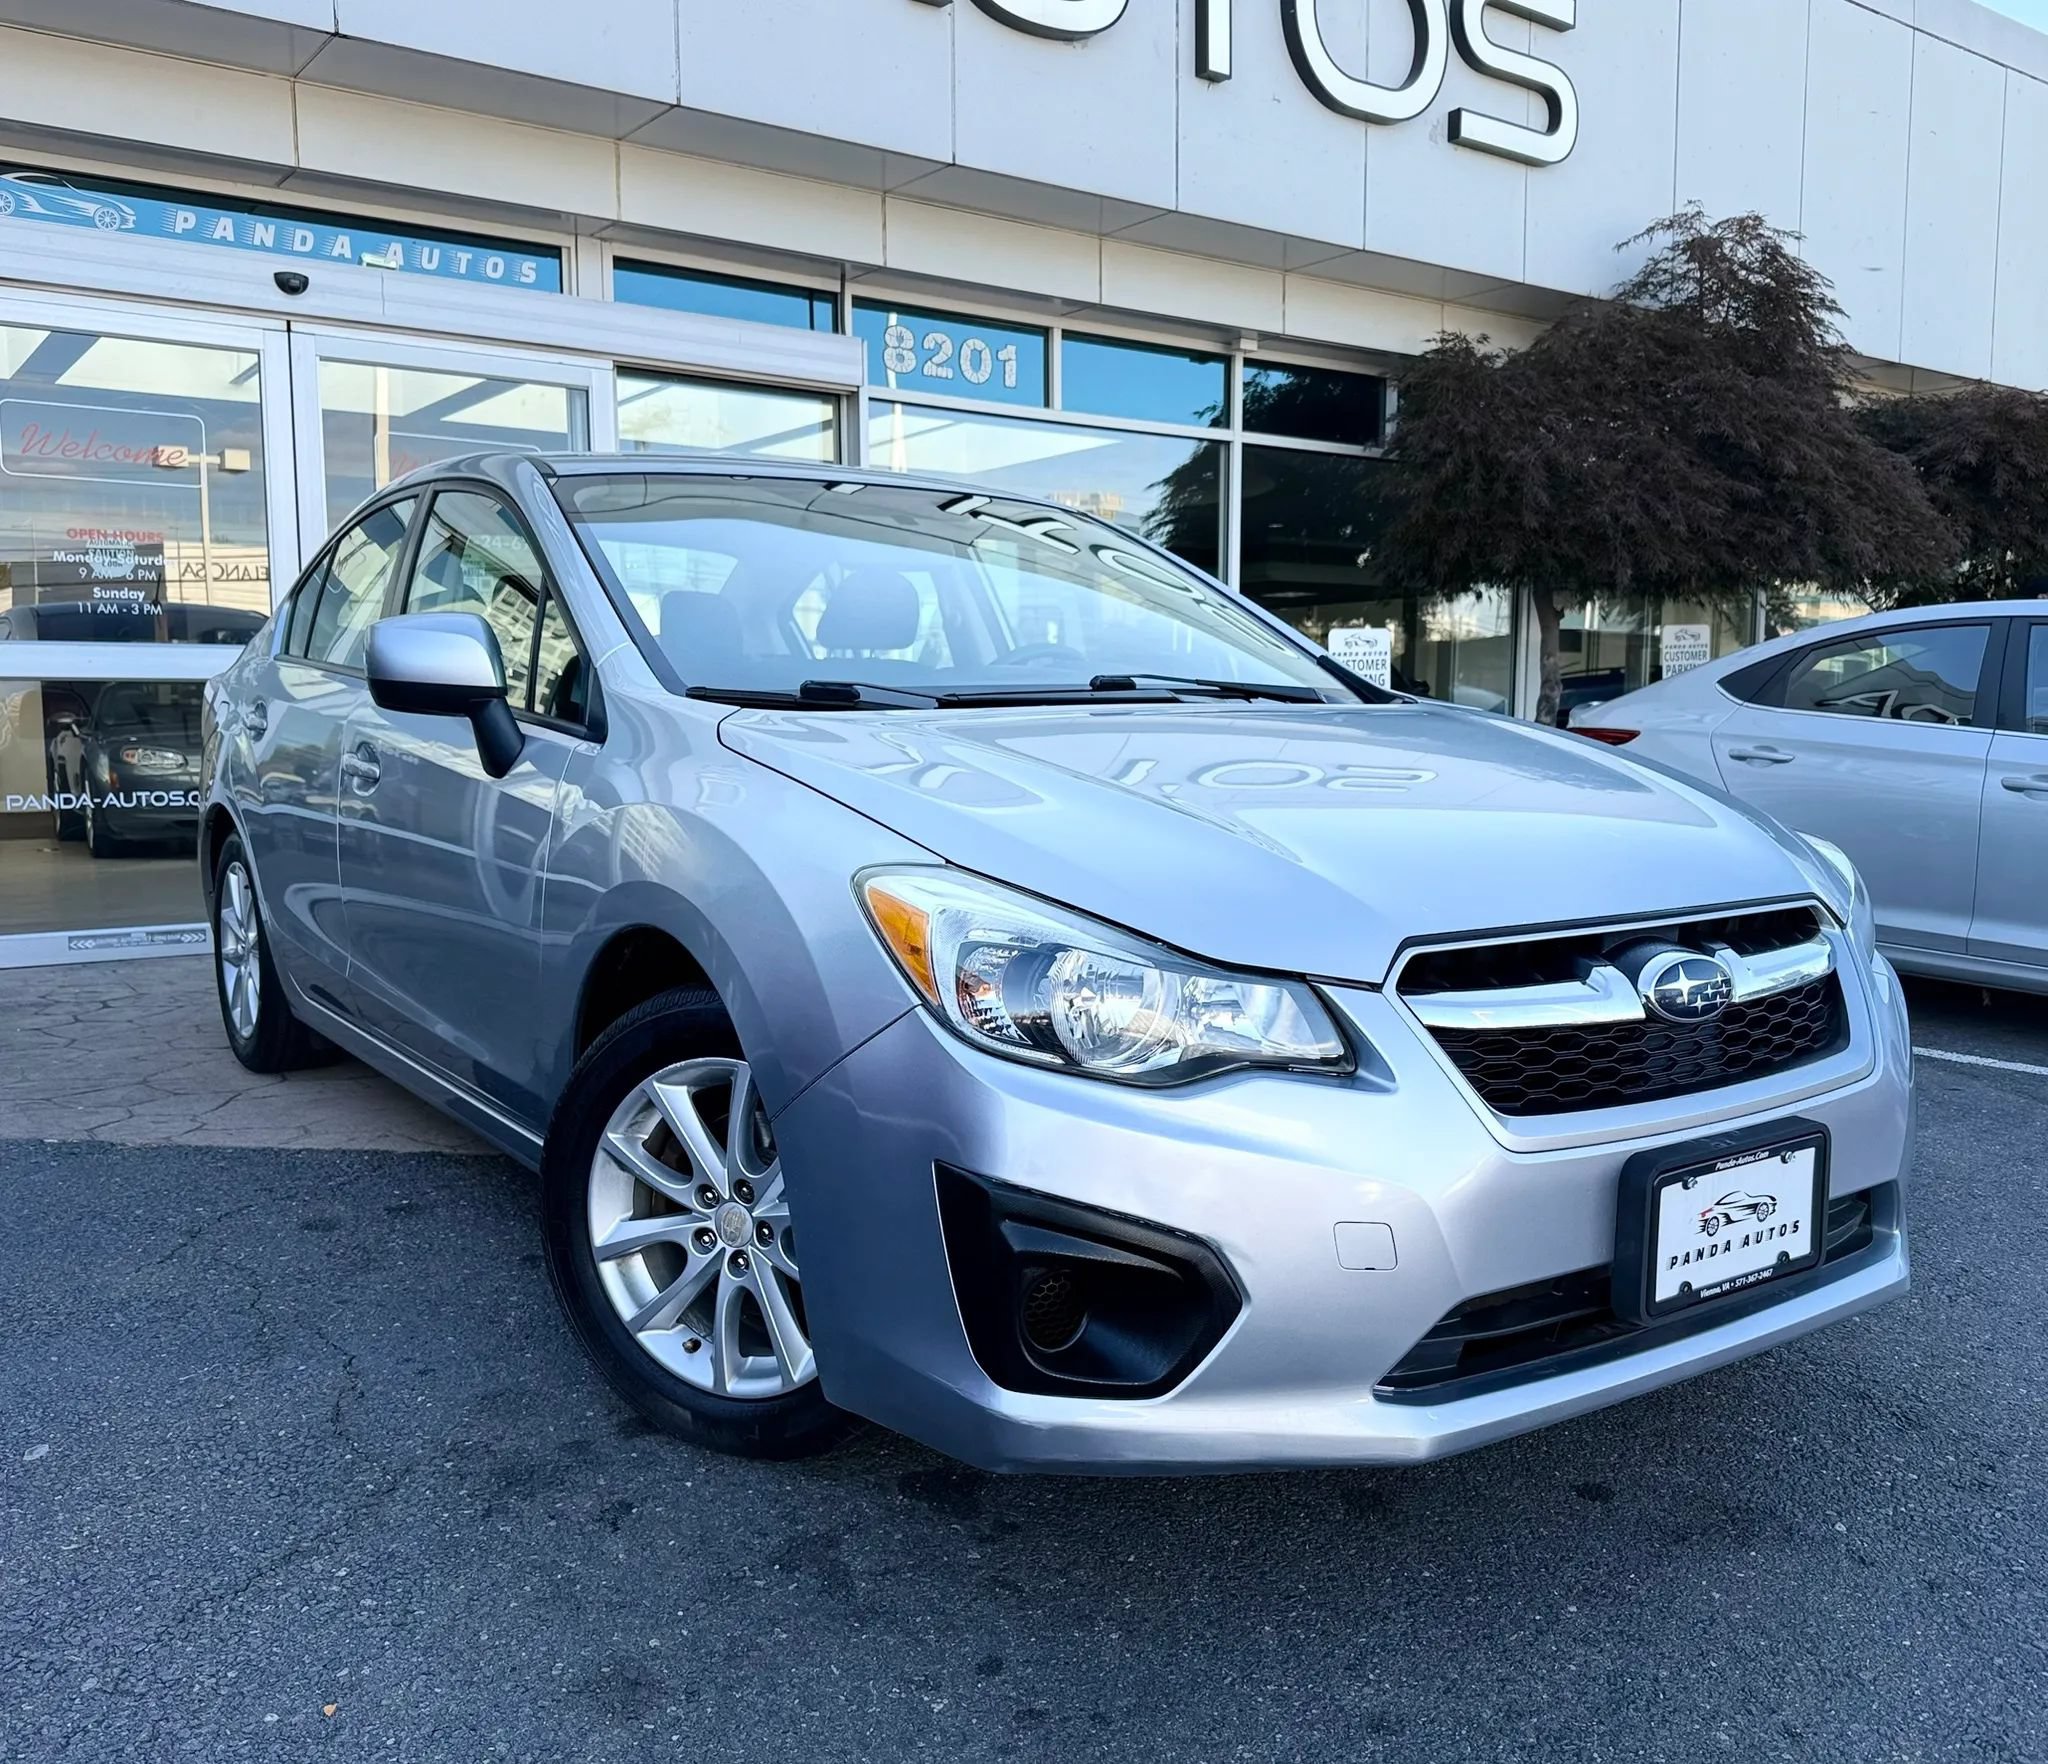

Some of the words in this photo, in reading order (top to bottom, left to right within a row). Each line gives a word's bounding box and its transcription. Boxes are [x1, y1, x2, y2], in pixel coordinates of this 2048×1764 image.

[172, 209, 352, 260] PANDA
[384, 242, 537, 284] AUTOS
[883, 325, 1017, 389] 8201
[19, 421, 188, 467] Welcome
[66, 528, 108, 541] OPEN
[115, 529, 165, 544] HOURS
[53, 550, 170, 567] Monday-Saturd
[78, 567, 88, 579] 9
[91, 568, 113, 580] AM
[125, 568, 134, 580] 6
[138, 569, 158, 581] PM
[92, 586, 146, 602] Sunday
[78, 602, 92, 614] 11
[97, 603, 119, 615] AM
[131, 604, 139, 615] 3
[144, 604, 163, 616] PM
[1664, 650, 1708, 662] CUSTOMER
[1342, 658, 1387, 671] STOMER
[1668, 1239, 1731, 1270] PANDA
[1741, 1219, 1800, 1248] AUTOS
